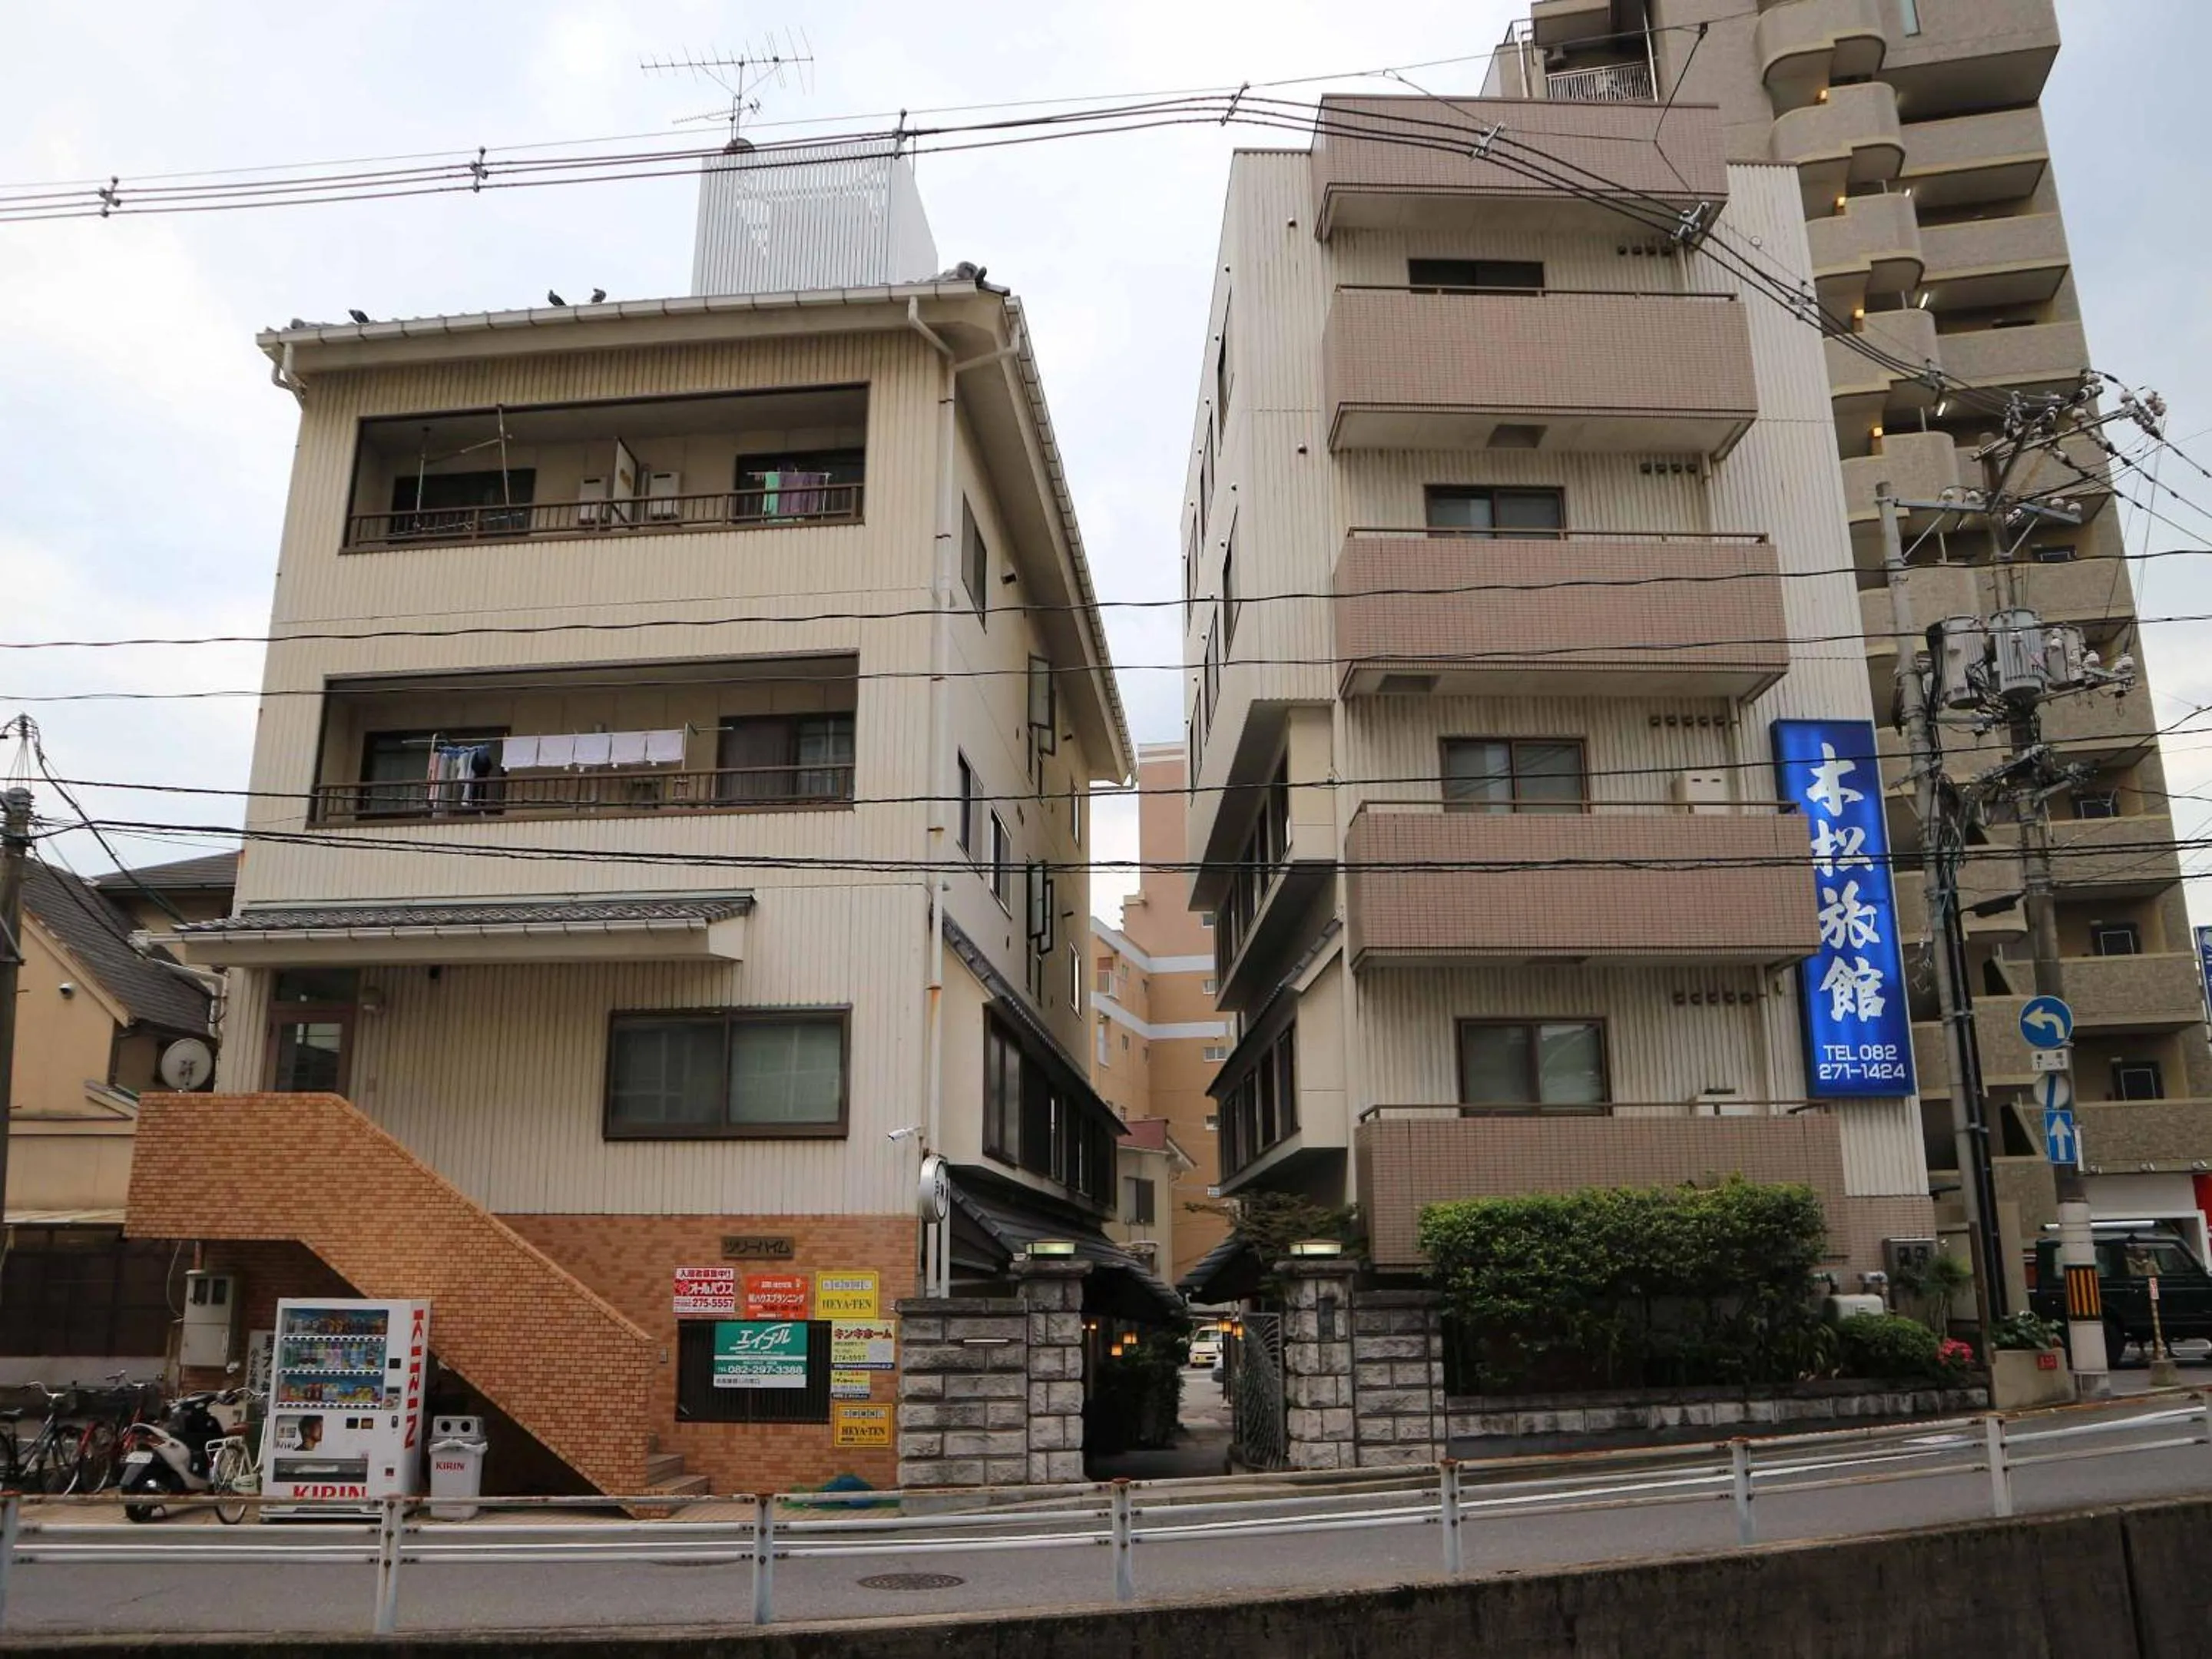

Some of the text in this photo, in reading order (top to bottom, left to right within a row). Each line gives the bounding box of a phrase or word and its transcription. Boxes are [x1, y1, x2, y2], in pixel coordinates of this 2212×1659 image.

[1823, 1045, 1898, 1061] TEL 082
[1819, 1063, 1906, 1080] 271-1424
[688, 1281, 734, 1295] オールハウス
[729, 1323, 793, 1350] エイブル
[404, 1308, 425, 1449] KIRIN
[435, 1462, 465, 1470] KIRIN
